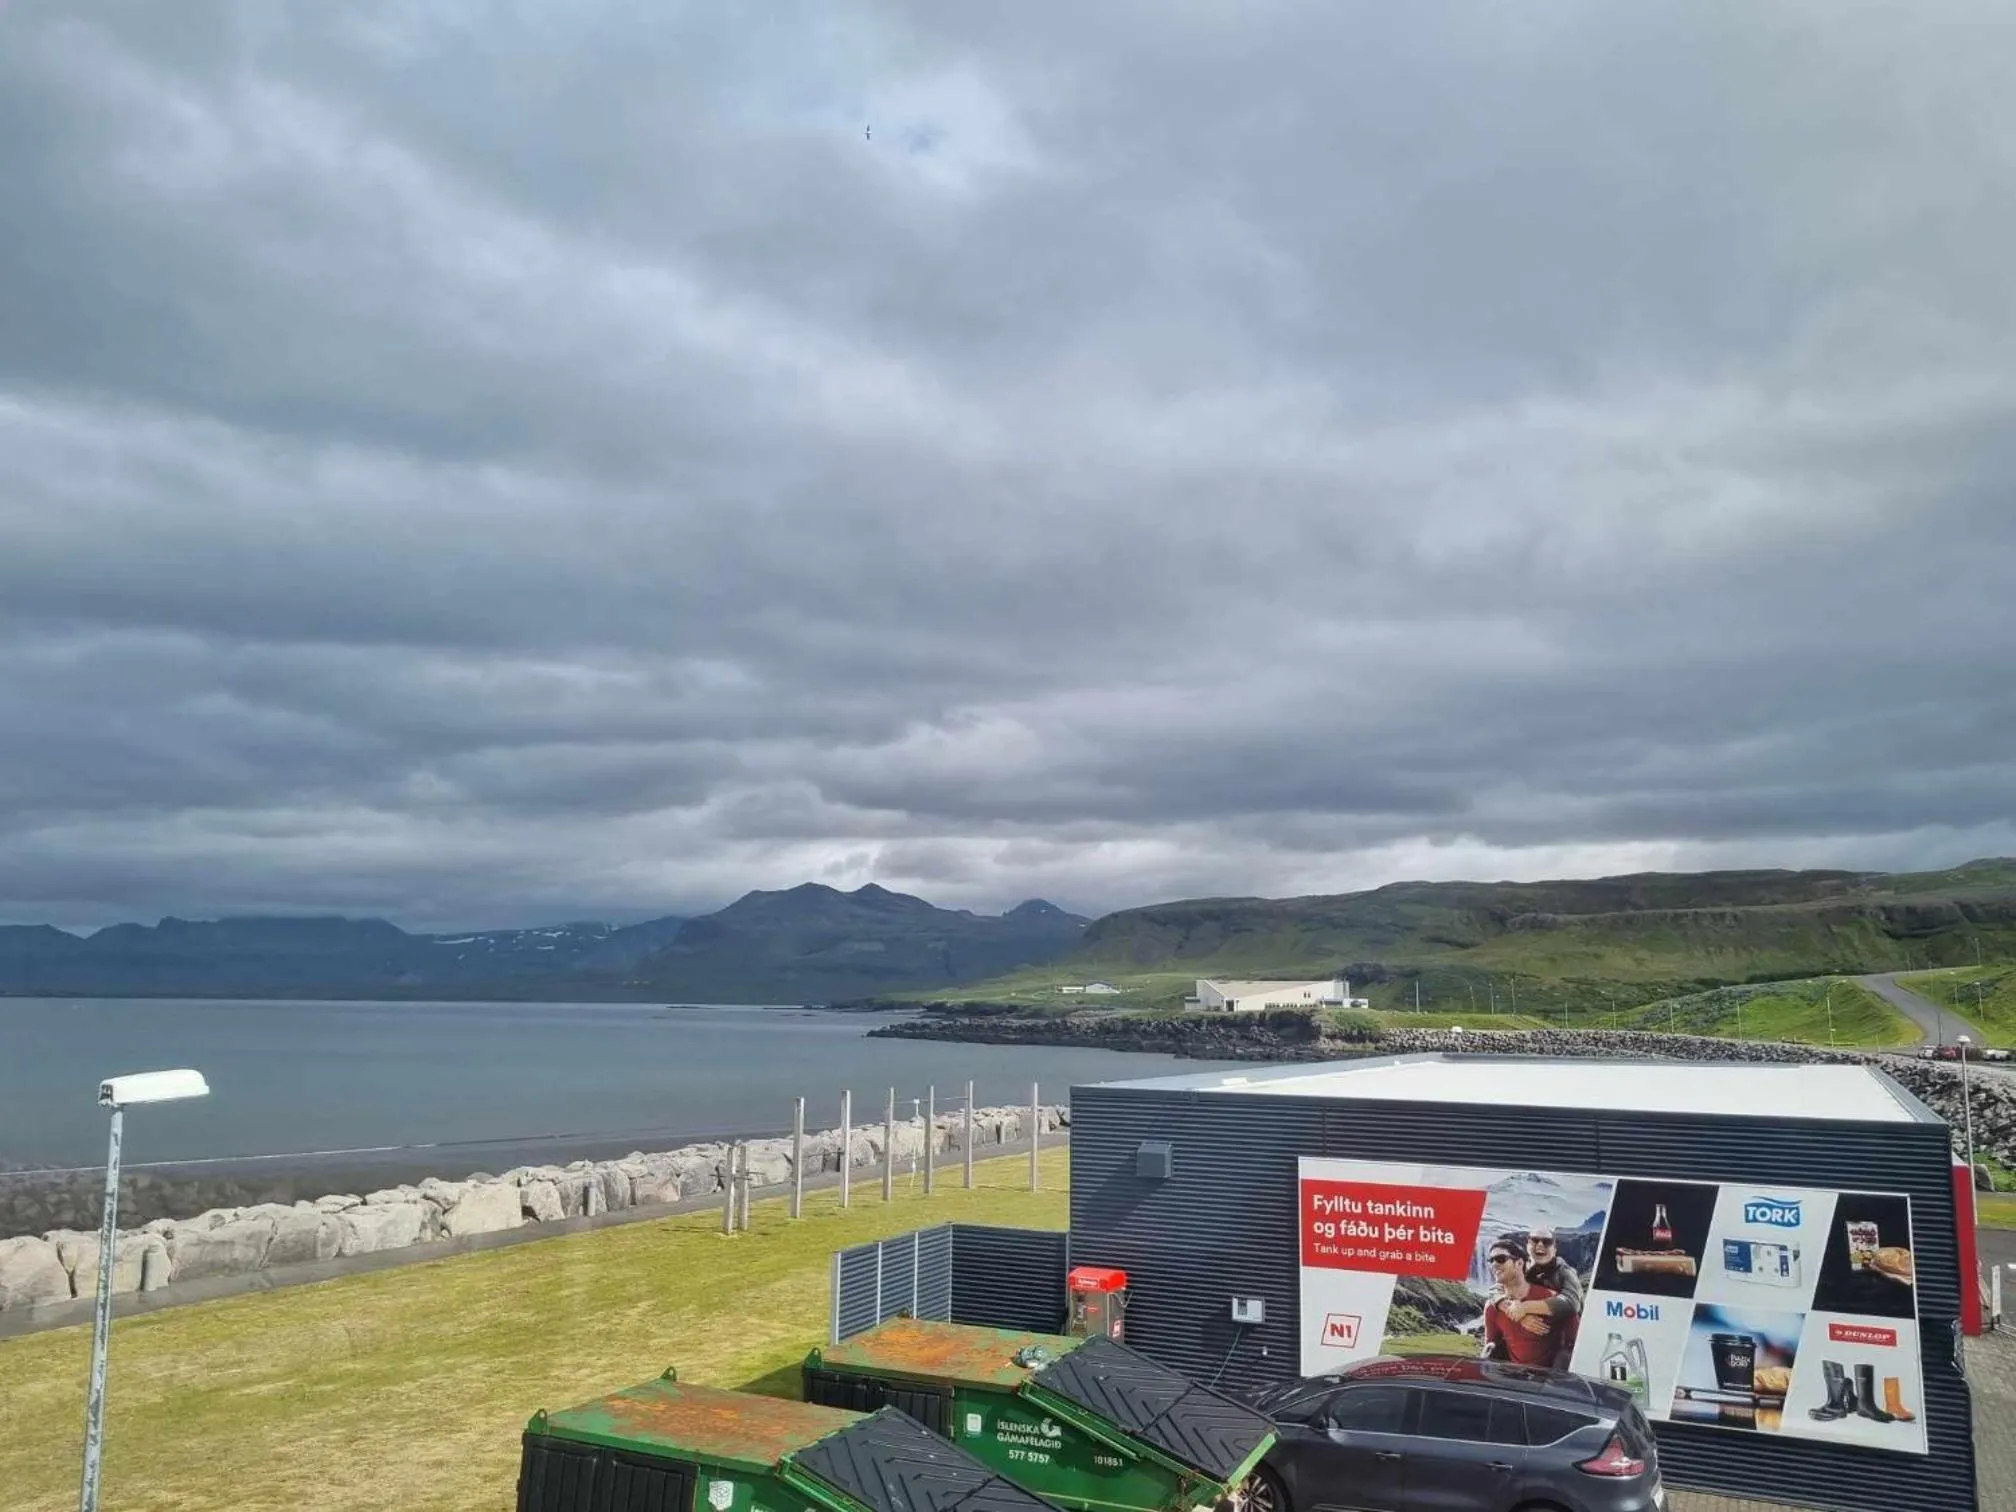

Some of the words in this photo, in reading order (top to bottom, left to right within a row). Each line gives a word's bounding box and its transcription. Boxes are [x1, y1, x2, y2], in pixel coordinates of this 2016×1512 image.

[1312, 1195, 1362, 1215] Fylltu
[1366, 1199, 1435, 1218] tankinn
[1746, 1206, 1797, 1224] TORK
[1313, 1222, 1336, 1238] og
[1339, 1219, 1379, 1238] fáðu
[1384, 1222, 1415, 1243] þér
[1419, 1225, 1455, 1245] bita
[1313, 1243, 1338, 1255] Tank
[1341, 1247, 1355, 1257] up
[1356, 1246, 1376, 1258] and
[1378, 1249, 1404, 1261] grab
[1405, 1252, 1412, 1260] a
[1414, 1250, 1436, 1263] bite
[1606, 1301, 1660, 1321] Mobil
[1330, 1323, 1352, 1339] N1
[1844, 1330, 1891, 1340] DUNLOP
[1008, 1449, 1025, 1460] 577
[1027, 1452, 1050, 1464] 5757
